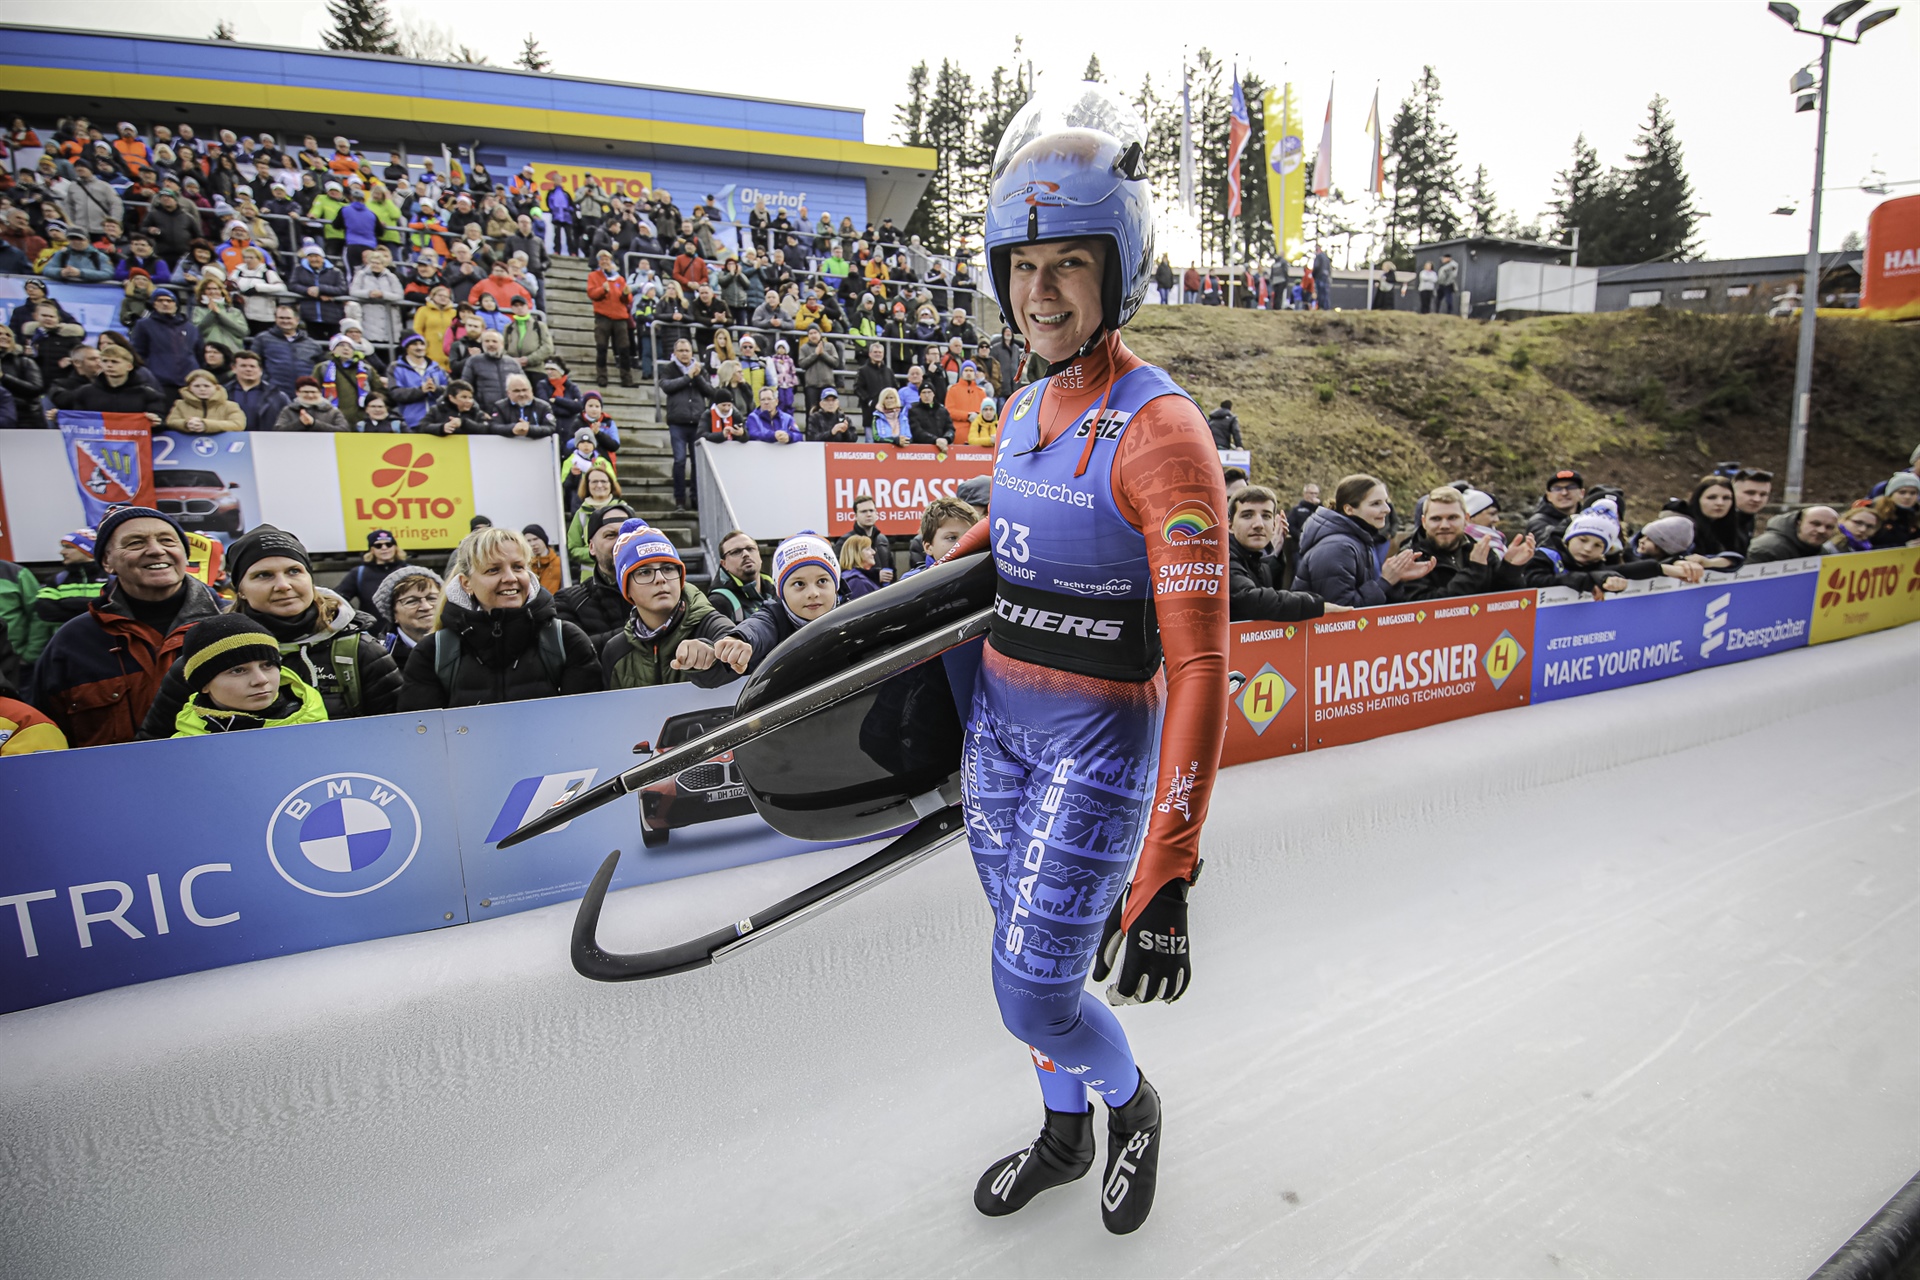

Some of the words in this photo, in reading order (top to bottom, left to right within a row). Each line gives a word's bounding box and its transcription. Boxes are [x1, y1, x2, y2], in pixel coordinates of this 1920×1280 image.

[741, 188, 806, 211] Oberhof
[996, 468, 1094, 509] Eberspächer
[356, 498, 454, 520] LOTTO
[995, 518, 1030, 563] 23
[1054, 579, 1132, 591] Prachtregion.de
[1847, 565, 1898, 603] LOTTO
[1434, 606, 1469, 619] HARGASSNER
[1487, 600, 1519, 612] HARGASSNER
[1315, 620, 1356, 634] HARGASSNER
[1377, 612, 1414, 626] HARGASSNER
[1241, 628, 1283, 643] HARGASSNER
[1547, 634, 1571, 650] JETZT
[1573, 630, 1616, 646] BEWERBEN!
[1727, 619, 1806, 651] Eberspächer
[1315, 643, 1477, 705] HARGASSNER
[1544, 656, 1592, 687] MAKE
[1598, 649, 1640, 677] YOUR
[1642, 640, 1683, 668] MOVE.
[1315, 698, 1363, 722] BIOMASS
[1366, 690, 1409, 712] HEATING
[1413, 680, 1476, 703] TECHNOLOGY
[974, 720, 984, 744] AG
[1190, 760, 1199, 772] AG
[285, 780, 397, 820] BMW
[1006, 757, 1075, 955] STADLER
[0, 863, 240, 958] TRIC
[1138, 927, 1186, 954] SEIZ
